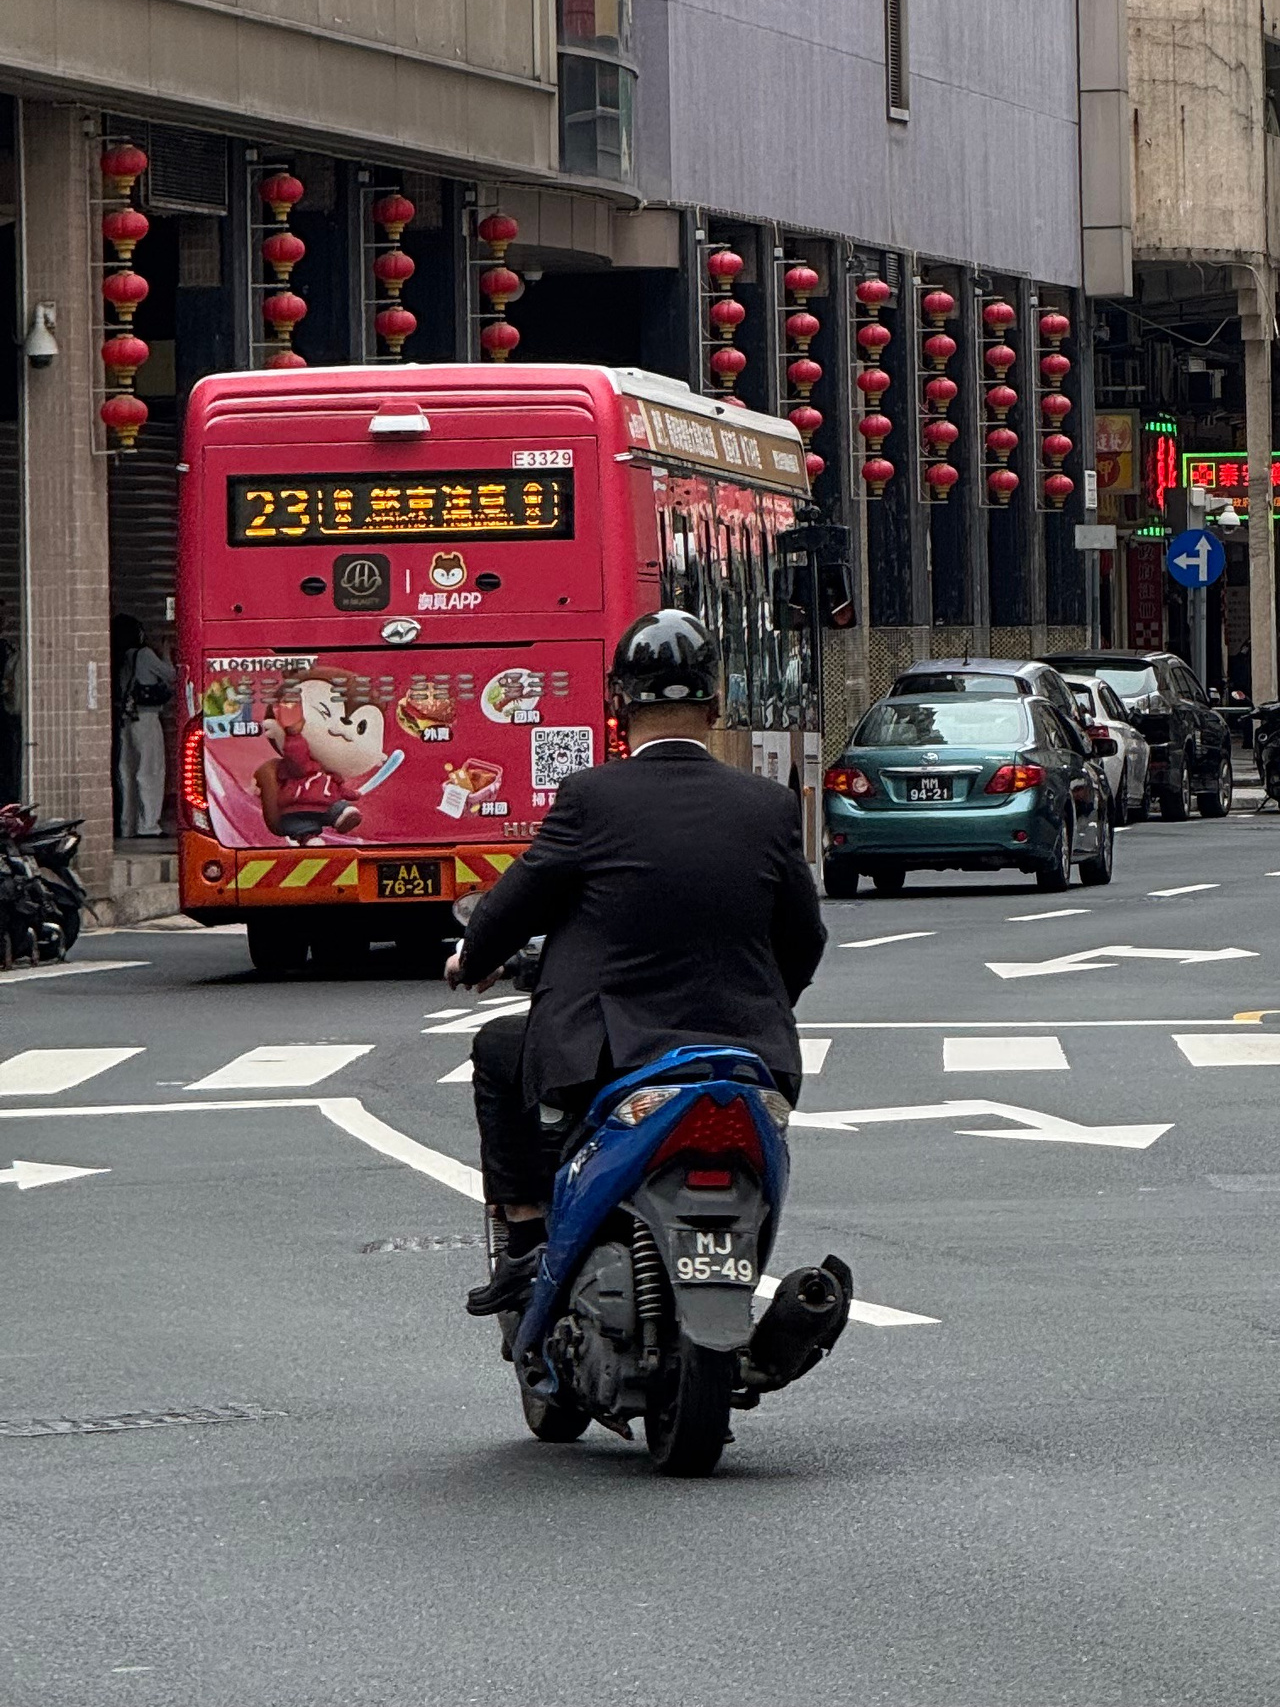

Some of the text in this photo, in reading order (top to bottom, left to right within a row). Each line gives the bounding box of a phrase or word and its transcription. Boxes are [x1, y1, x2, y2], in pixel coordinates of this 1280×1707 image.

[514, 452, 571, 467] E3329
[246, 490, 310, 537] 23
[921, 777, 939, 790] MM
[910, 787, 948, 801] 94-21
[398, 864, 420, 880] AA
[381, 878, 433, 895] 76-21
[696, 1232, 732, 1255] MJ
[677, 1257, 753, 1282] 95-49
